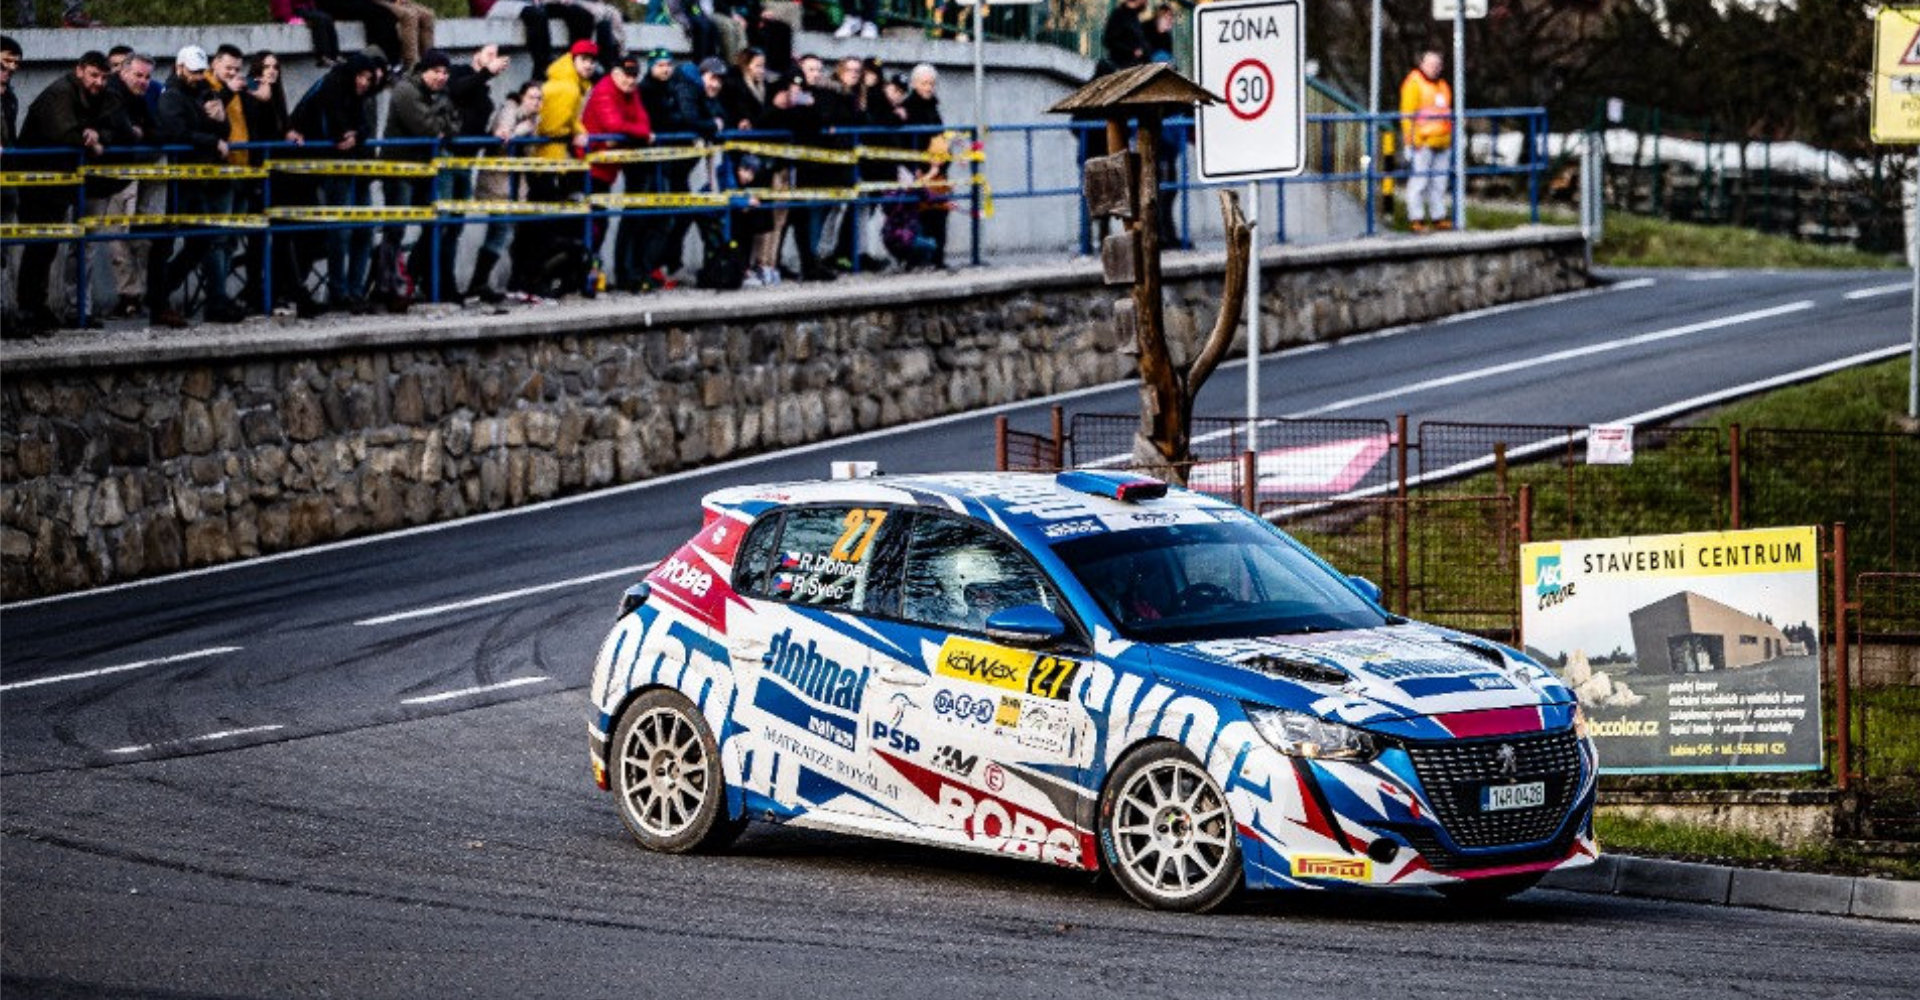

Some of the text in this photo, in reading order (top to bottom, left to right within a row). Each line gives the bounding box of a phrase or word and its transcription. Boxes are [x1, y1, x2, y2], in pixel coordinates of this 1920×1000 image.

[1218, 13, 1279, 43] ZÓNA
[1236, 75, 1263, 104] 30
[831, 508, 887, 563] 27
[1583, 541, 1803, 574] STAVEBNÍ CENTRUM
[1031, 656, 1075, 699] 27
[872, 720, 921, 754] PSP
[1298, 858, 1365, 877] PIRELLI
